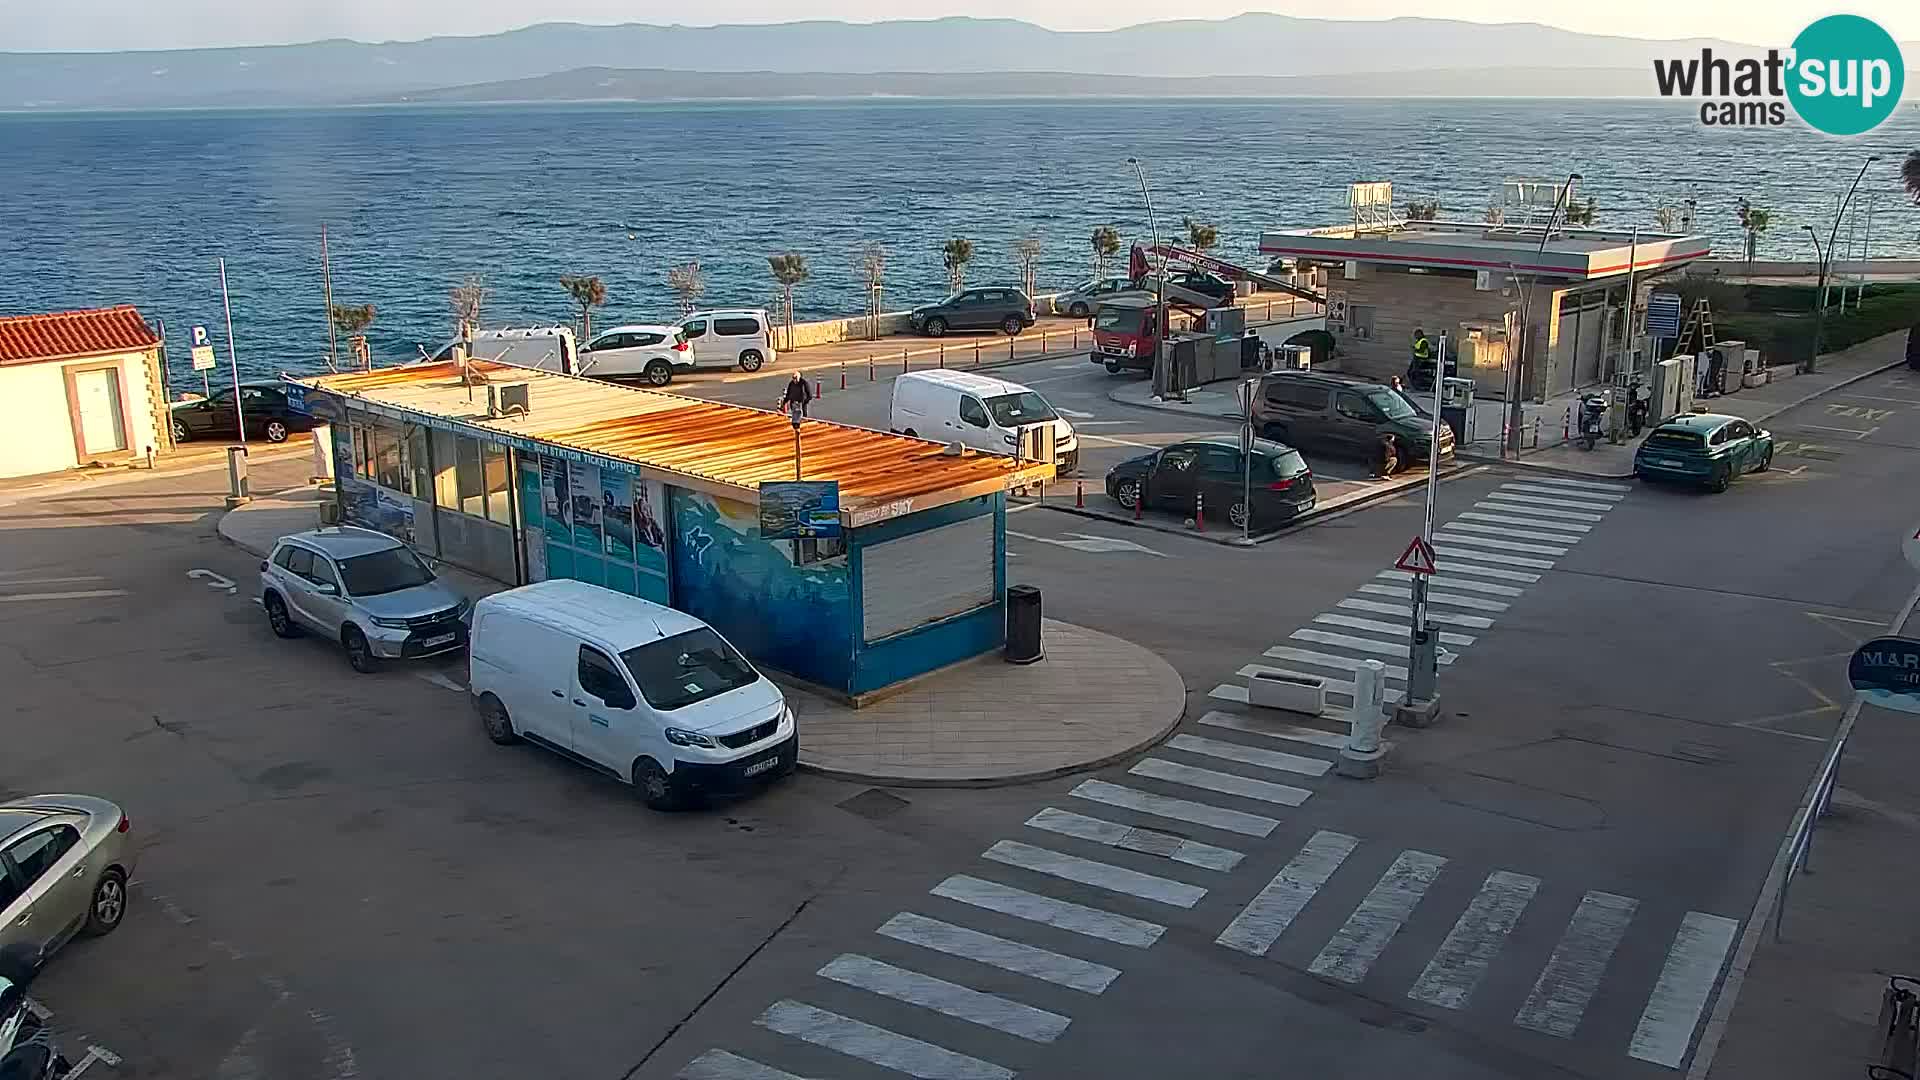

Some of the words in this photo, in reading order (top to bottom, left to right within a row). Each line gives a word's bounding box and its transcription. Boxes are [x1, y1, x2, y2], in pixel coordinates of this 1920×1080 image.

[194, 326, 207, 346] P
[550, 447, 581, 461] STATION
[584, 454, 609, 468] TICKET
[610, 460, 637, 474] OFFICE
